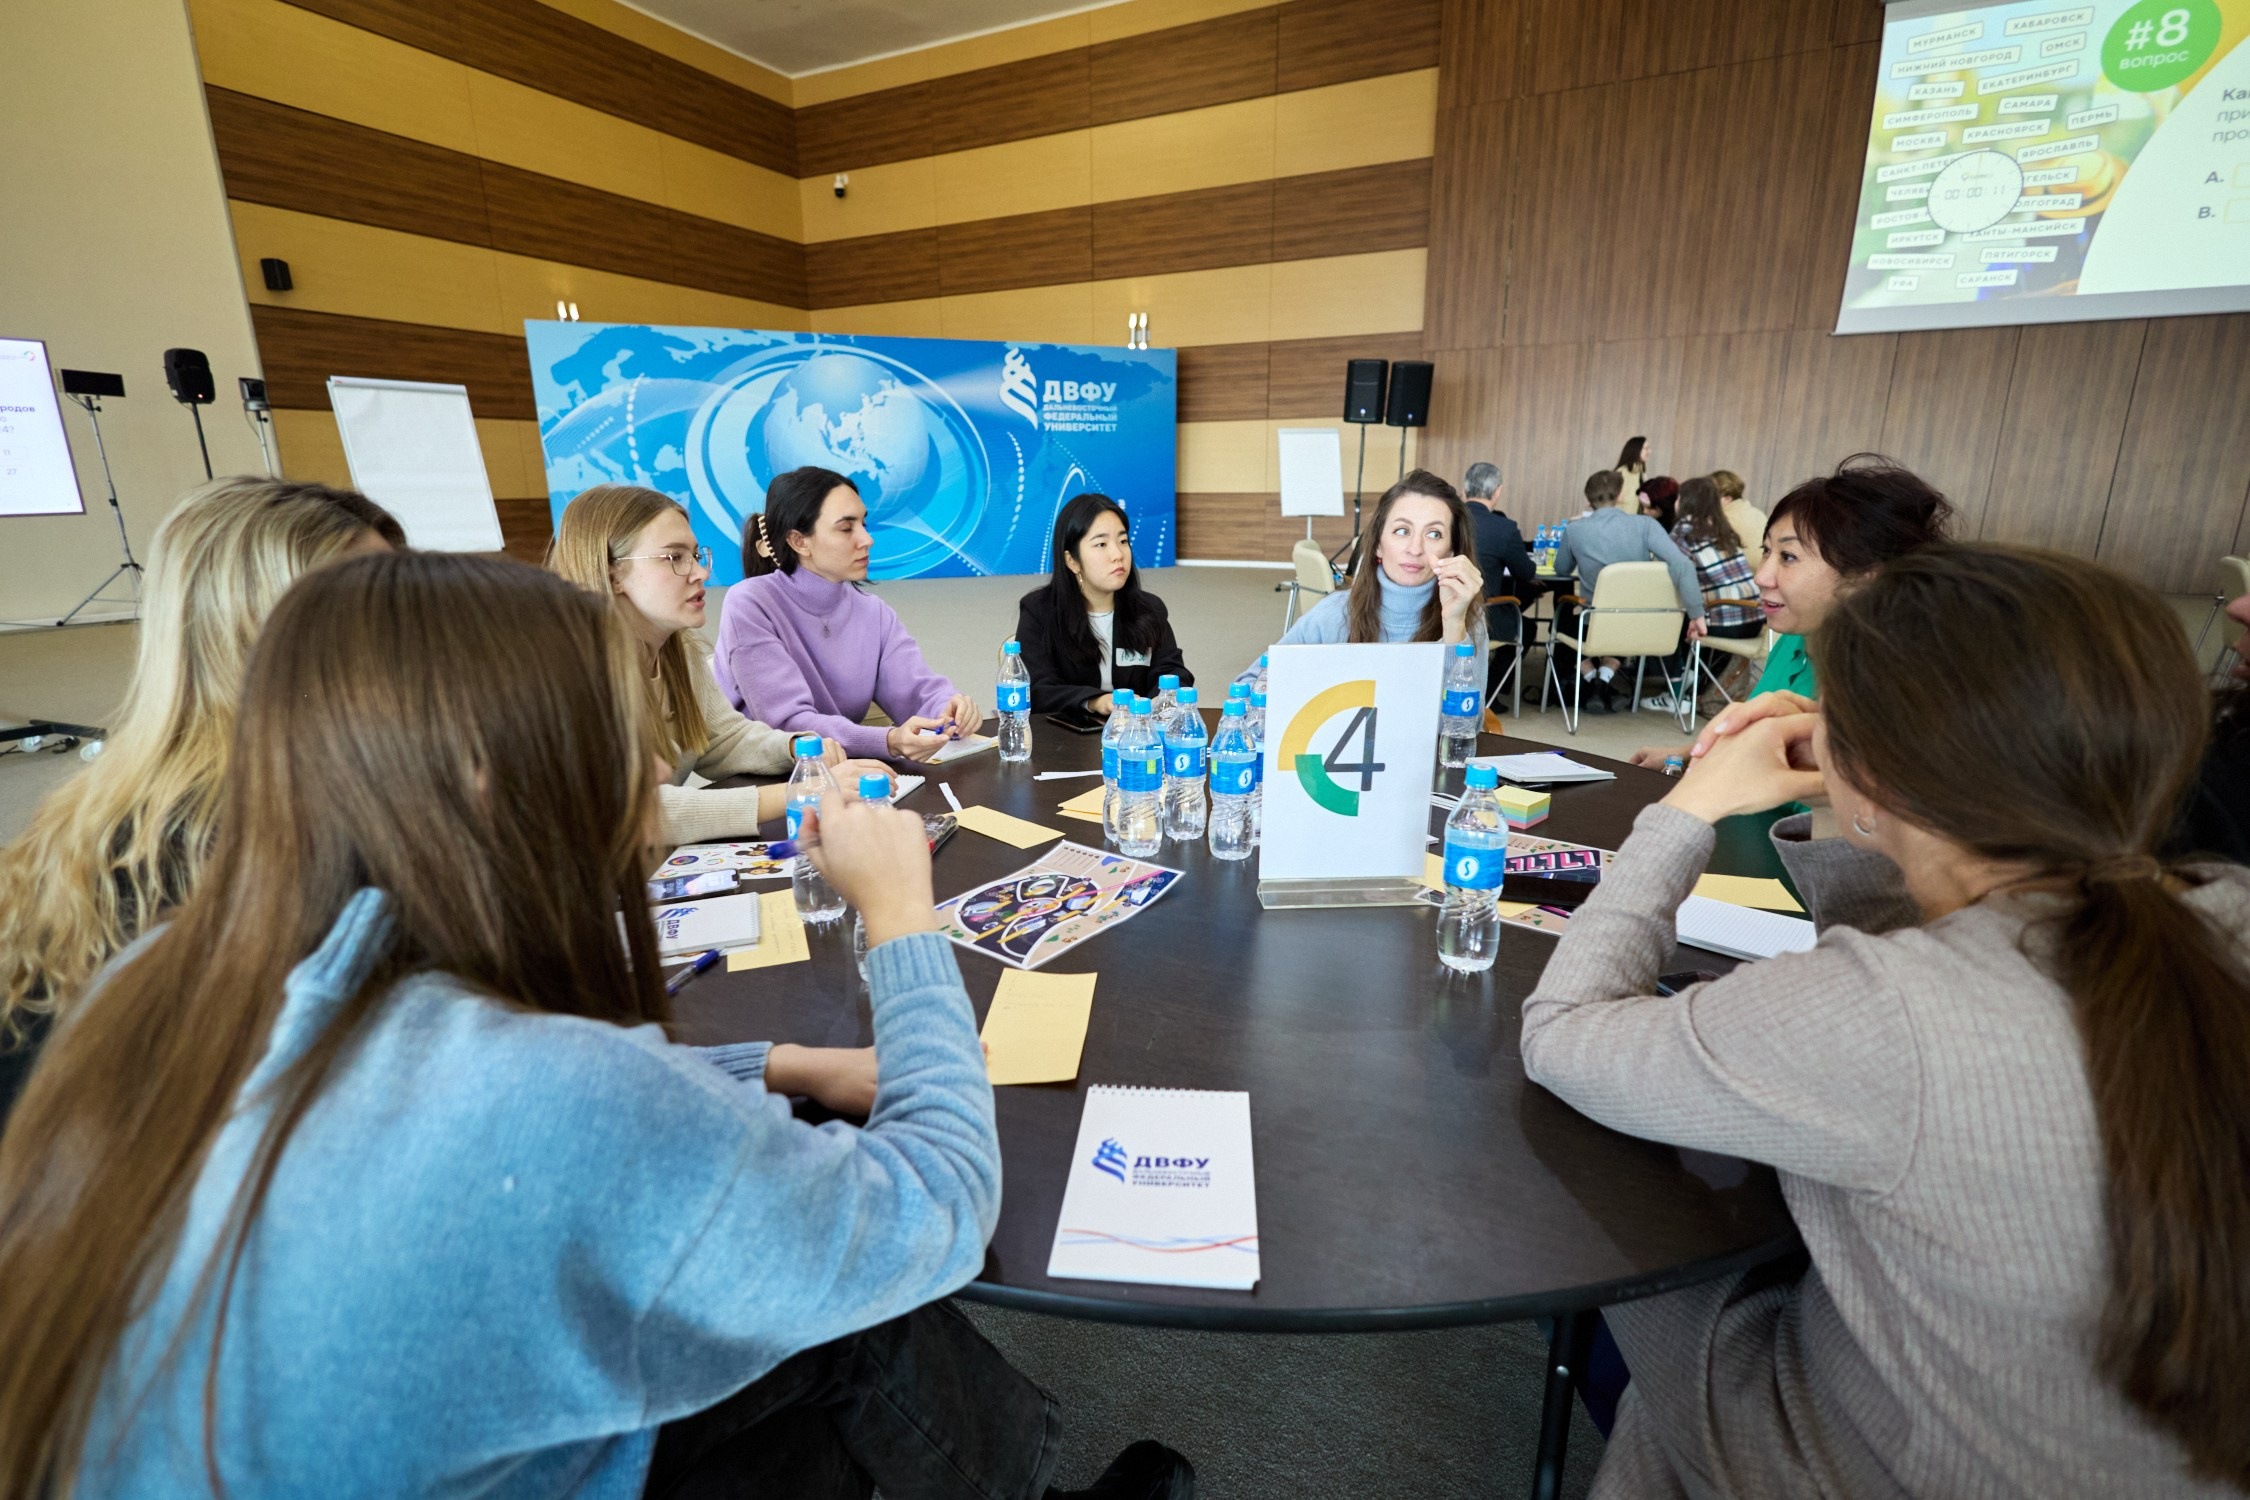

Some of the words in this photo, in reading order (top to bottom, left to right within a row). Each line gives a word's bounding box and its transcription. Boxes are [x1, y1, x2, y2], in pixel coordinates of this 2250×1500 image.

[2012, 13, 2085, 30] ХАБАРОВСК
[2124, 8, 2190, 51] #8
[1913, 28, 1977, 49] МУРМАНСК
[2045, 38, 2081, 52] ОМСК
[1897, 59, 1947, 74] НИЖНИЙ
[1950, 51, 2013, 67] НОВГОРОД
[2119, 50, 2189, 70] вопрос
[1982, 65, 2073, 91] ЕКАТЕРИНБУРГ
[1914, 85, 1958, 96] КАЗАНЬ
[2222, 88, 2250, 101] Ка
[2003, 99, 2052, 110] САМАРА
[1887, 108, 1973, 126] СИМФЕРОПОЛЬ
[2071, 110, 2113, 126] ПЕРМЬ
[1967, 123, 2044, 140] КРАСНОЯРСК
[1896, 135, 1942, 147] МОСКВА
[2022, 139, 2093, 158] ЯРОСЛАВЛЬ
[2022, 172, 2070, 184] ГЕЛЬСК
[1890, 233, 1940, 244] ИРКУТСК
[1871, 256, 1951, 266] НОВОСИБИРСК
[1984, 250, 2051, 260] ПЯТИГОРСК
[1960, 273, 2012, 285] САРАНСК
[1042, 380, 1117, 403] ДВФУ
[1043, 412, 1118, 422] ФЕДЕРАЛЬНЫЙ
[1043, 422, 1118, 433] УНИВЕРСИТЕТ
[1324, 706, 1386, 792] 4
[1134, 1156, 1210, 1169] ДВФУ
